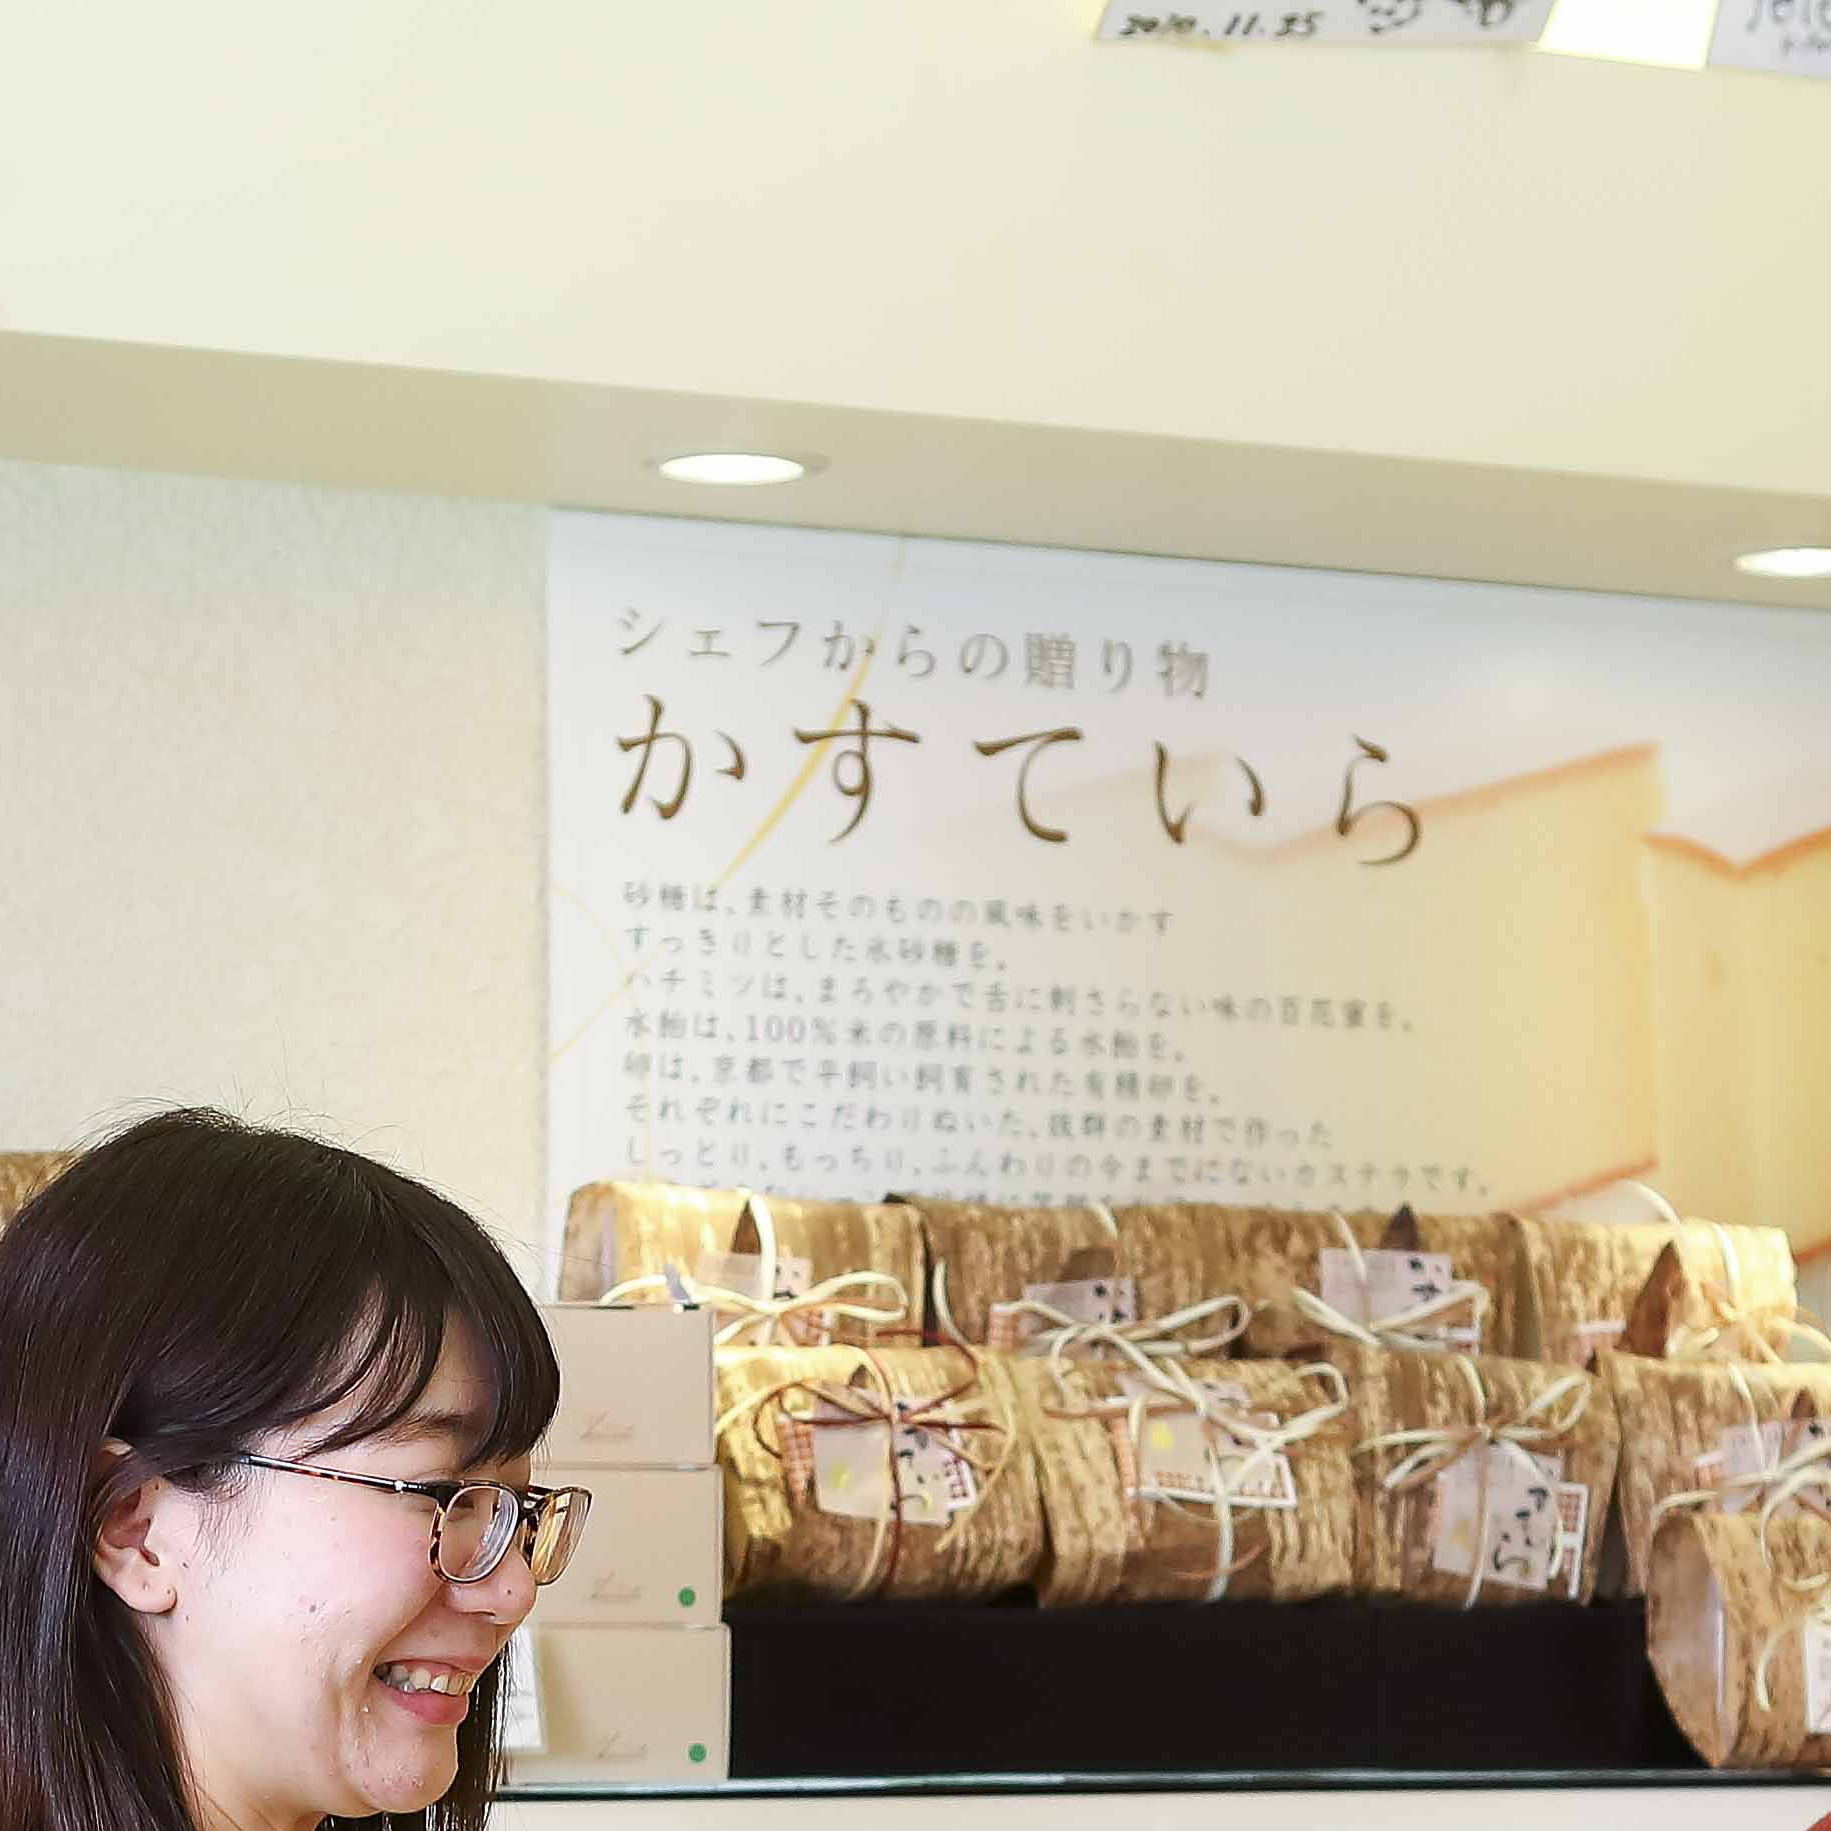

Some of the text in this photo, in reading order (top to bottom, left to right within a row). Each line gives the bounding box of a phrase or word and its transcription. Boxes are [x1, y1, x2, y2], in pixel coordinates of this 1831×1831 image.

[615, 607, 1210, 702] シェフからの贈り物
